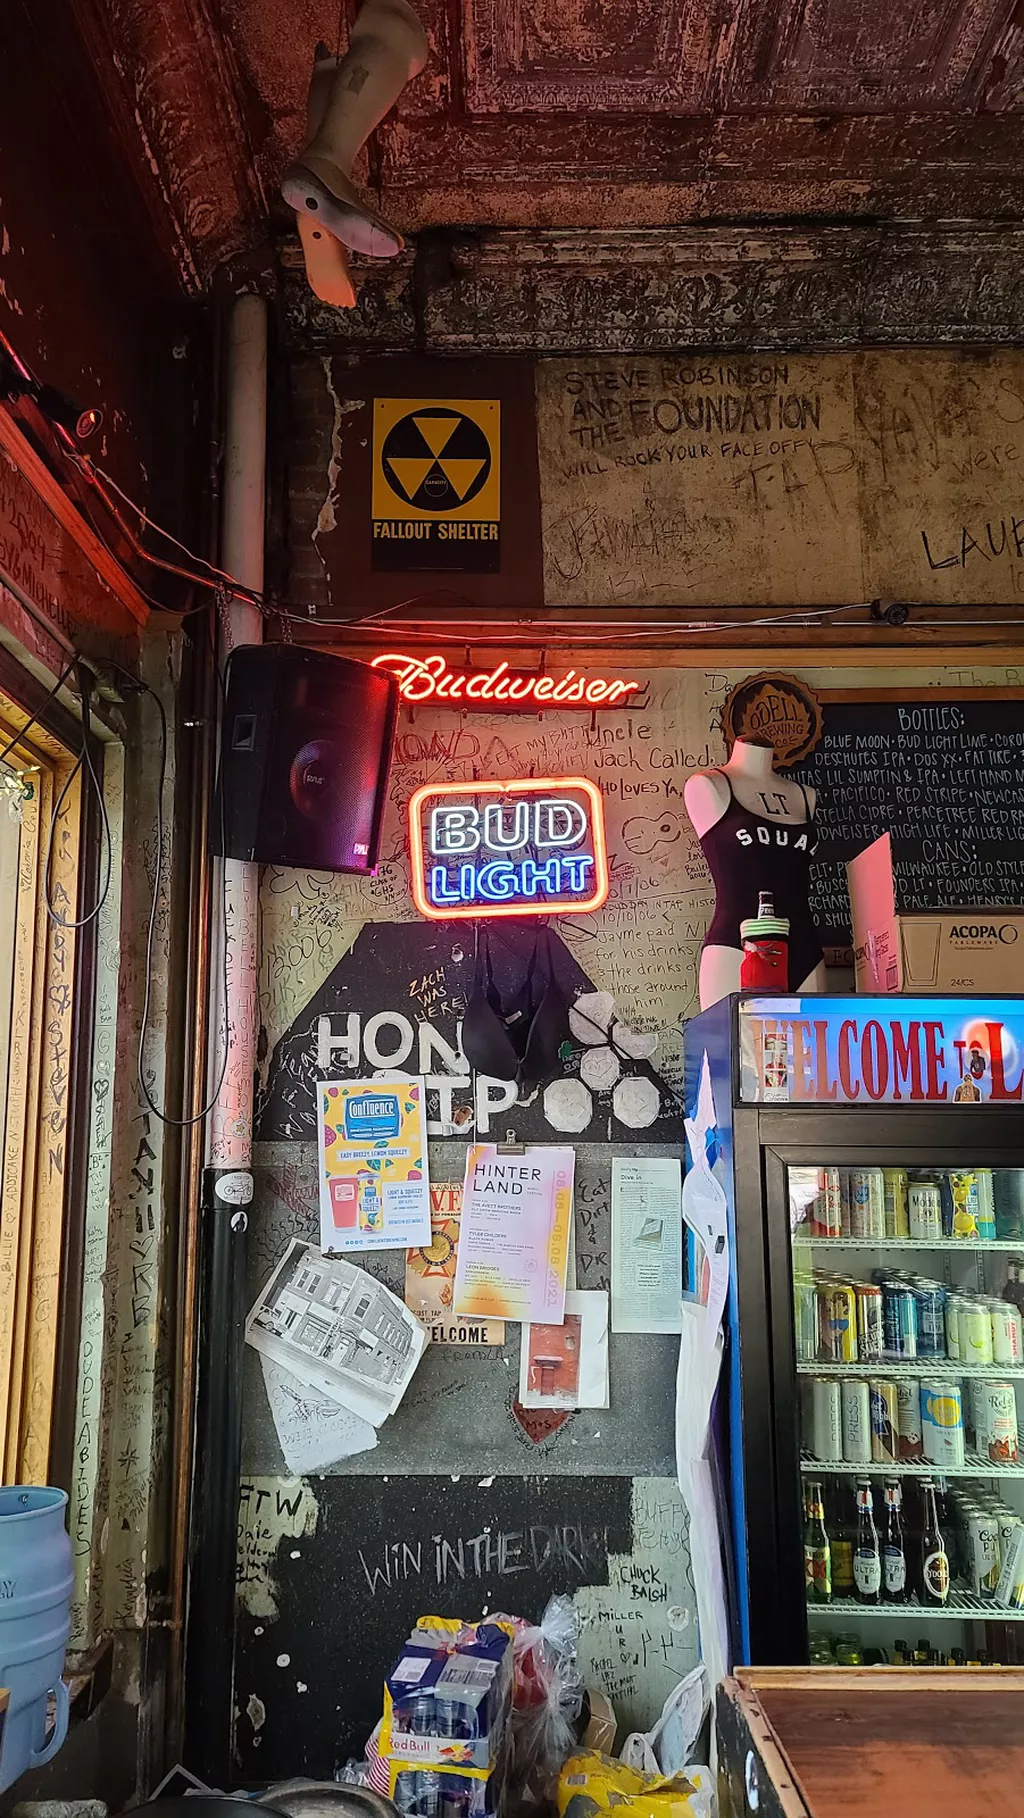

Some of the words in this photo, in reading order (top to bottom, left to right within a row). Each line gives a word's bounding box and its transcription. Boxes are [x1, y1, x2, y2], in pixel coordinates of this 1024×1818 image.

[565, 370, 650, 395] STEVE
[661, 365, 788, 386] ROBINSON
[572, 399, 623, 421] AND
[629, 394, 821, 438] FOUNDATION
[569, 422, 625, 448] THE
[563, 462, 608, 480] WILL
[615, 449, 662, 469] ROCK
[665, 444, 713, 465] YOUR
[720, 442, 763, 458] FACE
[373, 522, 432, 541] FALLOUT
[438, 523, 499, 541] SHELTER
[371, 652, 639, 703] Budweiser
[750, 695, 803, 731] ODELL
[898, 706, 965, 732] BOTTLES:
[587, 718, 651, 746] Uncle
[824, 735, 852, 749] BLUE
[855, 735, 890, 749] MOON
[898, 735, 921, 749] BUD
[925, 735, 957, 749] LIGHT
[960, 733, 987, 749] LIME
[594, 746, 645, 772] Jack
[815, 752, 878, 766] DESCHUTES
[883, 752, 906, 768] IPA
[914, 757, 938, 767] DOS
[941, 753, 958, 768] XX
[964, 751, 985, 765] FAT
[988, 749, 1011, 764] TIRE
[826, 770, 844, 785] LIL
[848, 769, 902, 785] SUMPTIN
[904, 772, 912, 783] &
[917, 770, 940, 785] IPA
[950, 769, 976, 785] LEFT
[979, 769, 1012, 786] HAND
[620, 778, 660, 800] LOVES
[832, 786, 885, 802] PACIFICO
[896, 786, 921, 802] RED
[924, 788, 967, 803] STRIPE
[757, 791, 790, 816] LT
[815, 805, 857, 824] STELLA
[859, 805, 895, 821] CIDRE
[906, 807, 976, 823] PEACETREE
[982, 808, 1009, 824] RED
[431, 799, 588, 855] BUD
[924, 824, 951, 839] LIFE
[962, 825, 1003, 841] MILLER
[922, 840, 977, 863] CANS:
[430, 855, 594, 902] LIGHT
[970, 862, 993, 877] OLD
[913, 878, 925, 892] LT
[937, 877, 995, 893] FOUNDERS
[999, 877, 1018, 892] IPA
[647, 922, 675, 942] paid
[949, 926, 998, 938] ACOPA
[595, 948, 616, 961] for
[623, 947, 644, 960] his
[648, 941, 694, 958] drinks
[606, 963, 633, 979] the
[637, 961, 682, 976] drinks
[409, 966, 446, 998] ZACH
[645, 980, 689, 993] around
[414, 992, 469, 1024] HERE!
[417, 988, 448, 1008] WAS
[349, 1099, 395, 1119] Confluence
[474, 1163, 542, 1181] HINTER
[473, 1179, 523, 1195] LAND
[579, 1177, 610, 1203] Eat
[428, 1326, 488, 1343] ELCOME
[1010, 1322, 1018, 1357] SHANDY
[848, 1395, 860, 1443] PRESS
[466, 1530, 531, 1579] THE
[620, 1564, 661, 1585] CHUCK
[388, 1738, 409, 1750] Red
[409, 1739, 430, 1751] Bull
